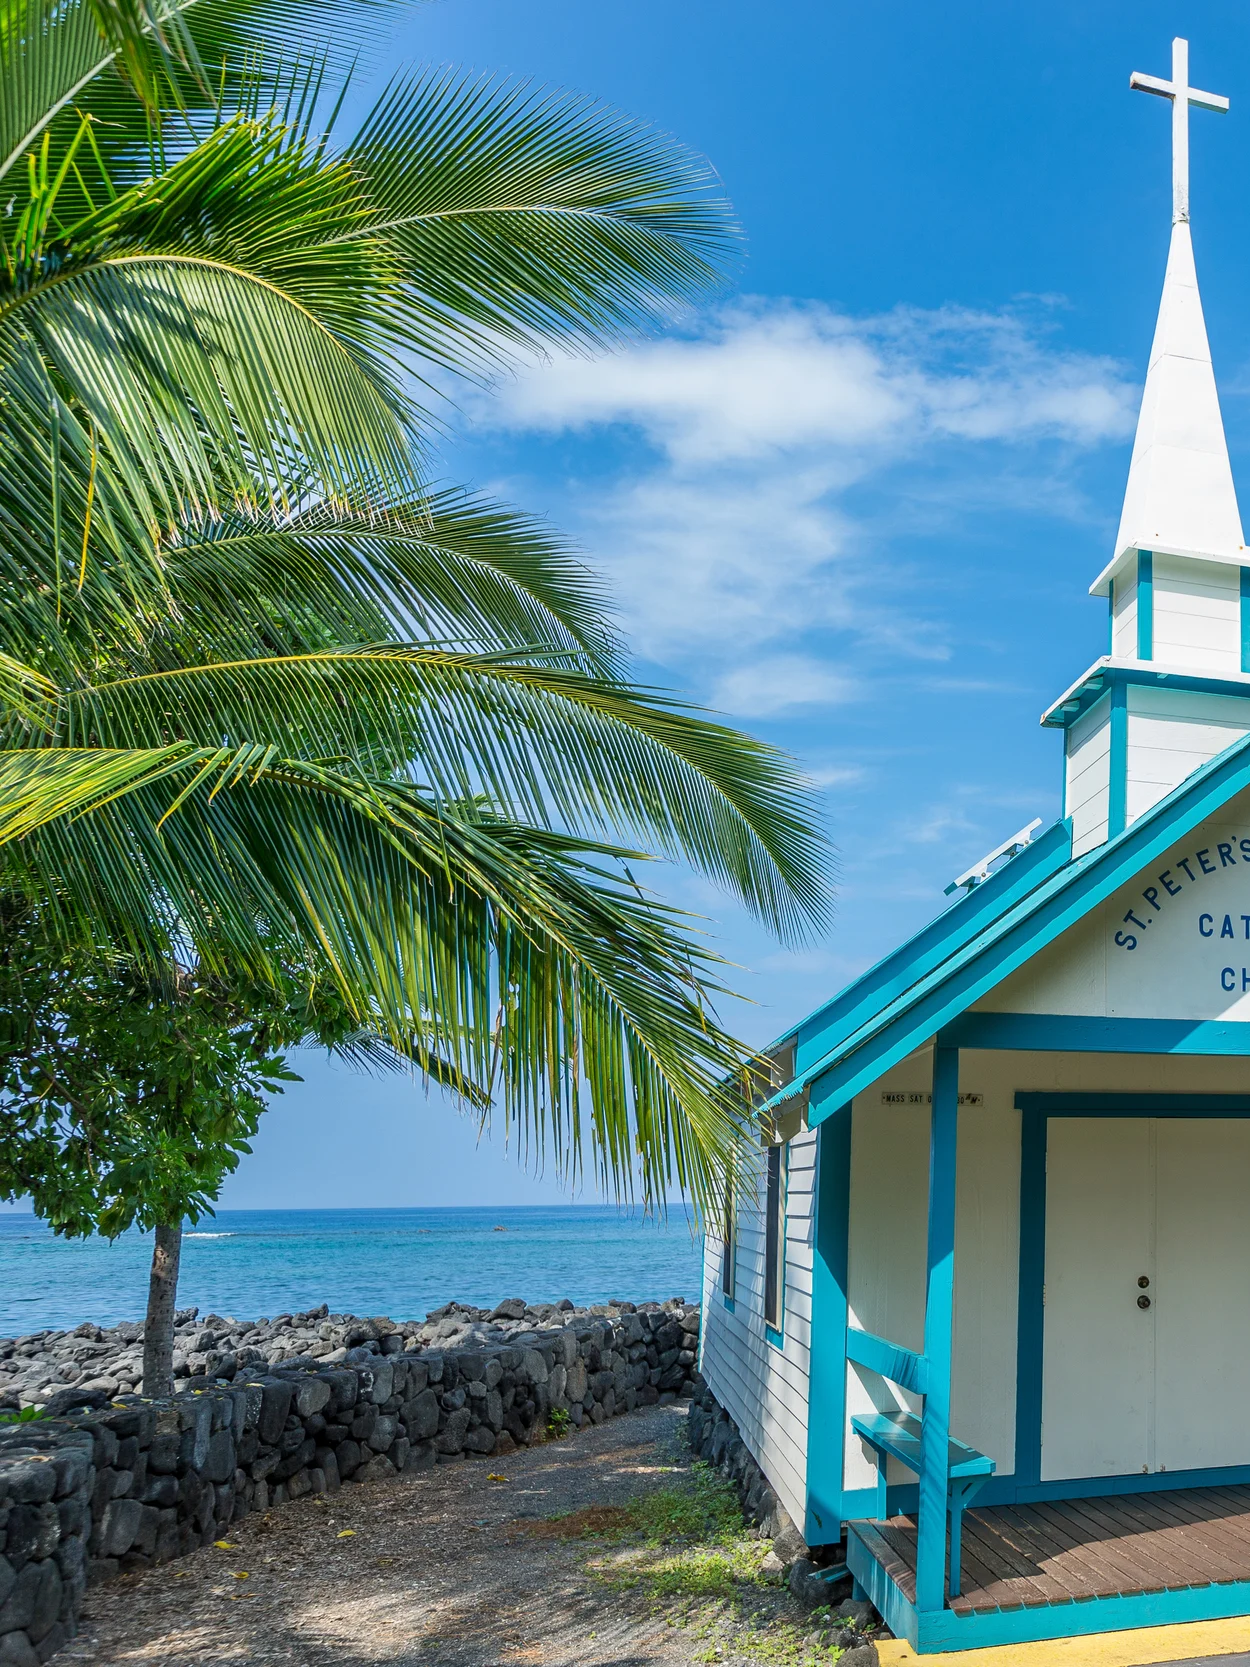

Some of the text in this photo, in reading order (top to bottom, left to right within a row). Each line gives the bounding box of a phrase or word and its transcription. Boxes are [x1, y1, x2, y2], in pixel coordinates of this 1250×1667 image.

[1115, 910, 1152, 951] ST.
[886, 1094, 905, 1103] MASS
[909, 1094, 923, 1103] SAT
